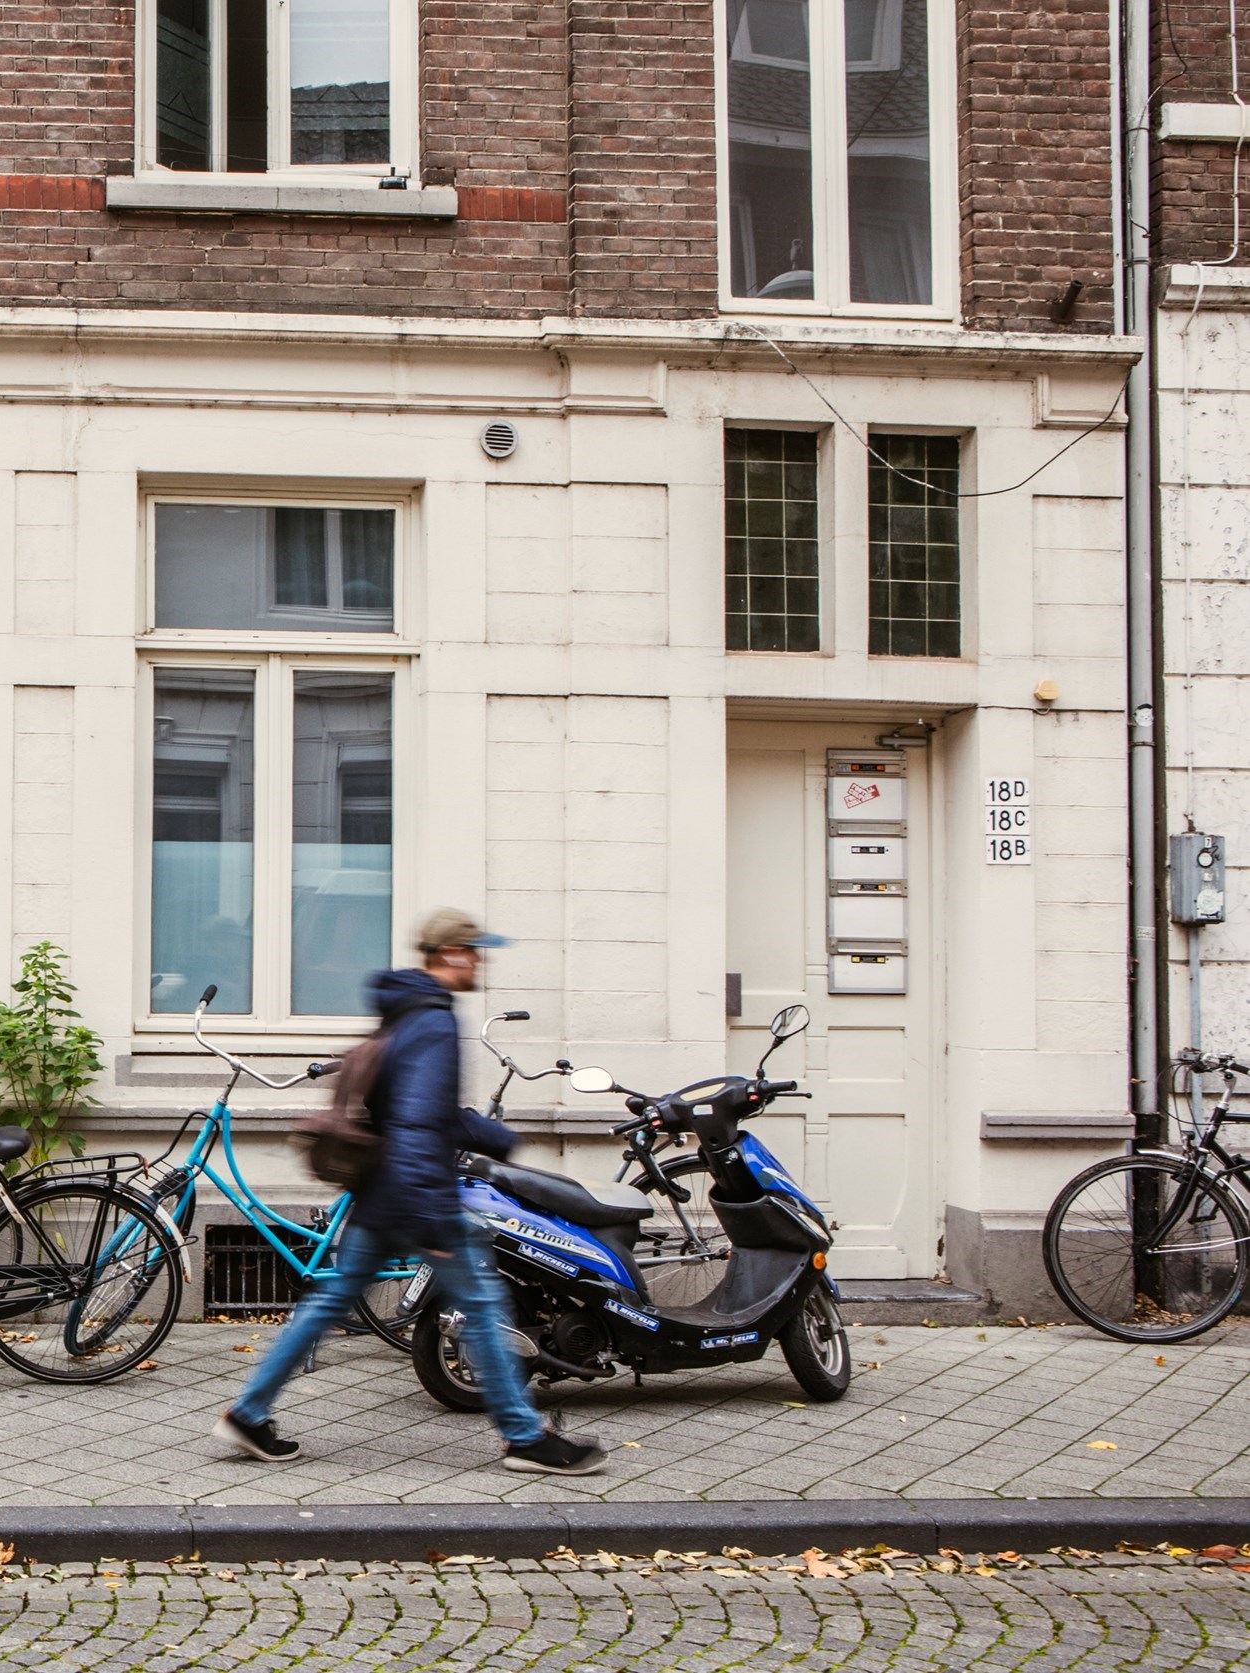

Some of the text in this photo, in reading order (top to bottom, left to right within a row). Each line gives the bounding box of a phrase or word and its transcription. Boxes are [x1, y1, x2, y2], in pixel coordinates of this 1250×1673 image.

[989, 781, 1025, 802] 18D
[990, 810, 1026, 831] 18C
[990, 840, 1026, 861] 18B
[506, 1218, 575, 1248] Off Limit
[532, 1251, 577, 1274] MICHELIN
